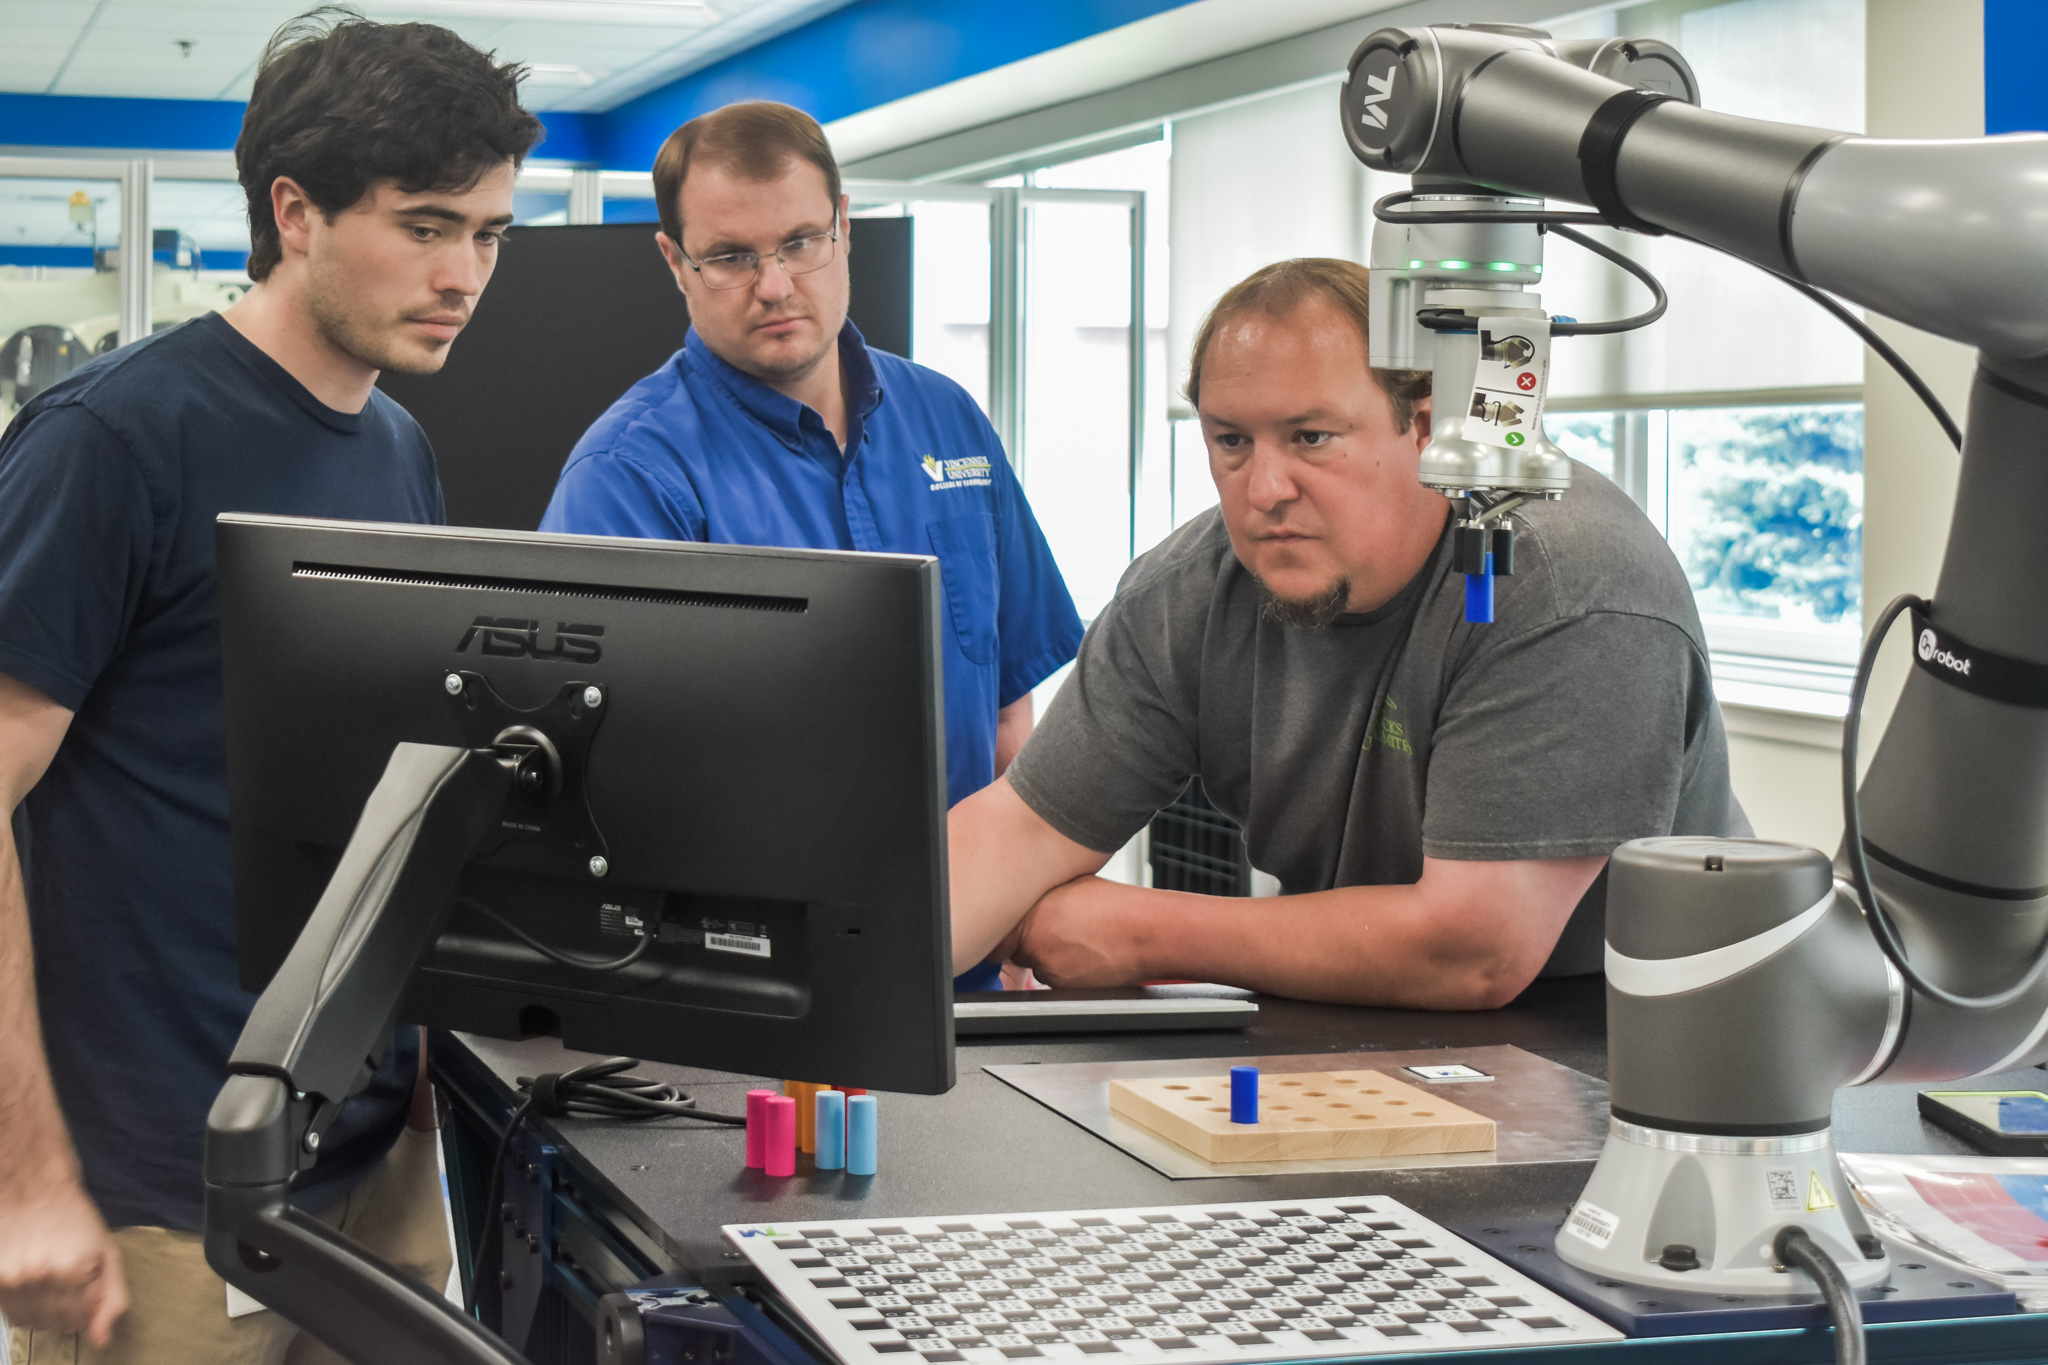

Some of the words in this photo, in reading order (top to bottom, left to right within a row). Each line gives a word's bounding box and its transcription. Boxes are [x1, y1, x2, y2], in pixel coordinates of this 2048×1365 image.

[946, 467, 991, 480] UNIVERSITY
[456, 615, 605, 665] ASUS
[601, 903, 622, 911] ASUS
